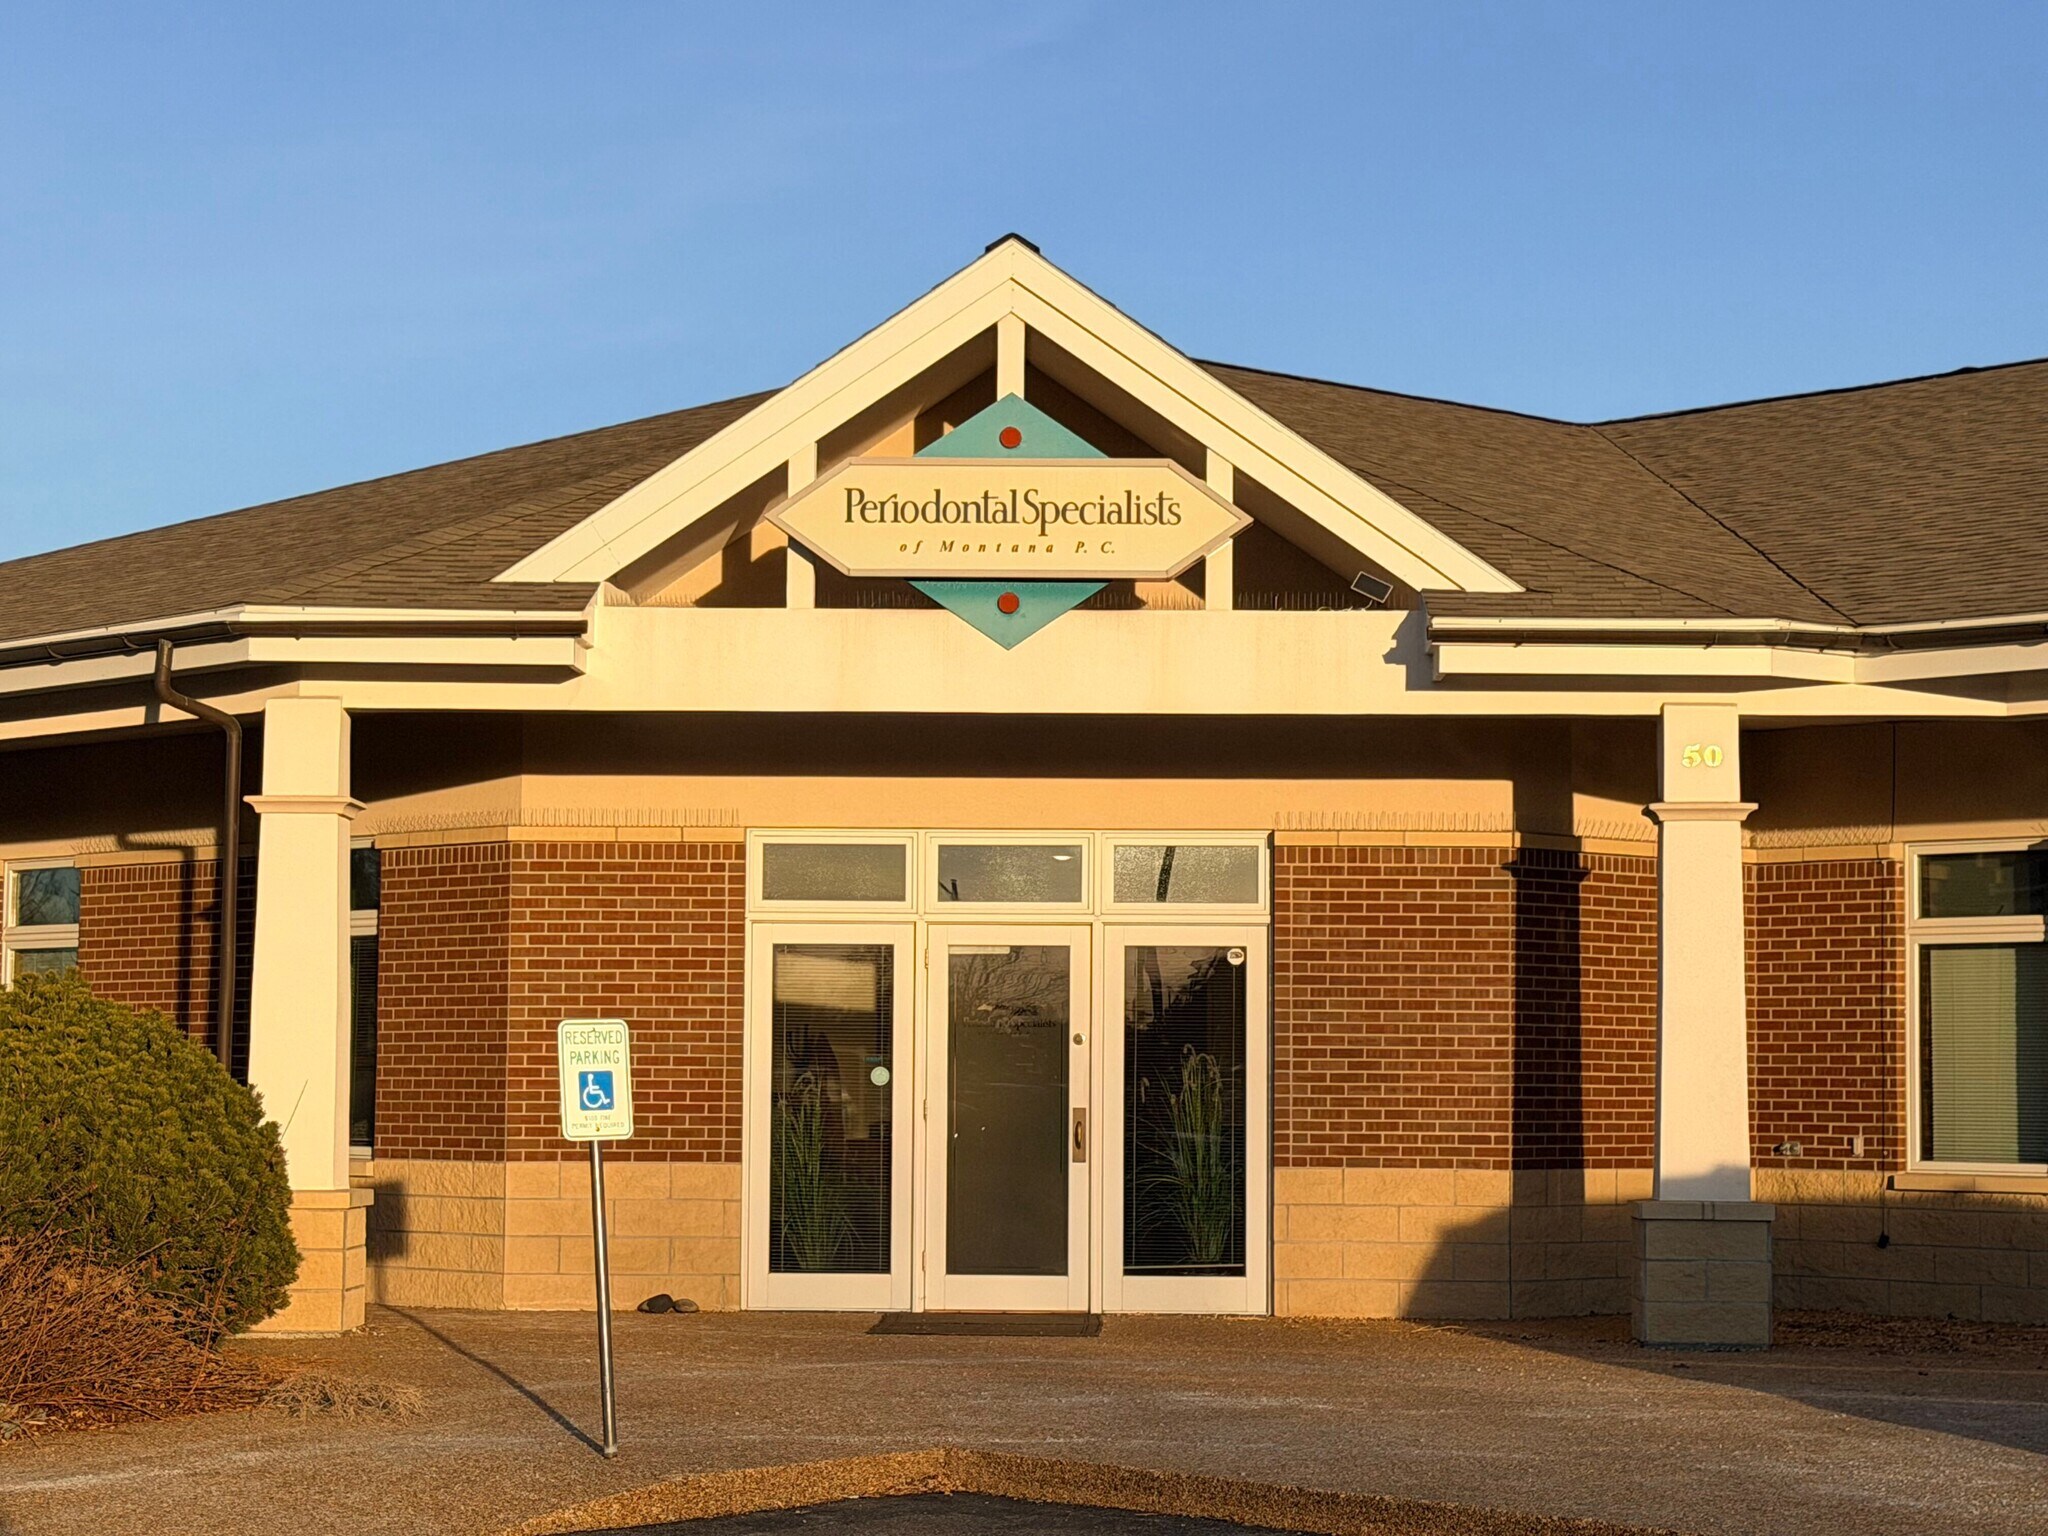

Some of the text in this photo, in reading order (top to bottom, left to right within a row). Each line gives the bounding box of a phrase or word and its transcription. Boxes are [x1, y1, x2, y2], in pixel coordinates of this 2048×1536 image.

[899, 540, 924, 555] of
[938, 540, 1054, 554] Montana
[1681, 743, 1723, 769] 50
[565, 1030, 623, 1045] RESERVED
[570, 1050, 620, 1065] PARKING
